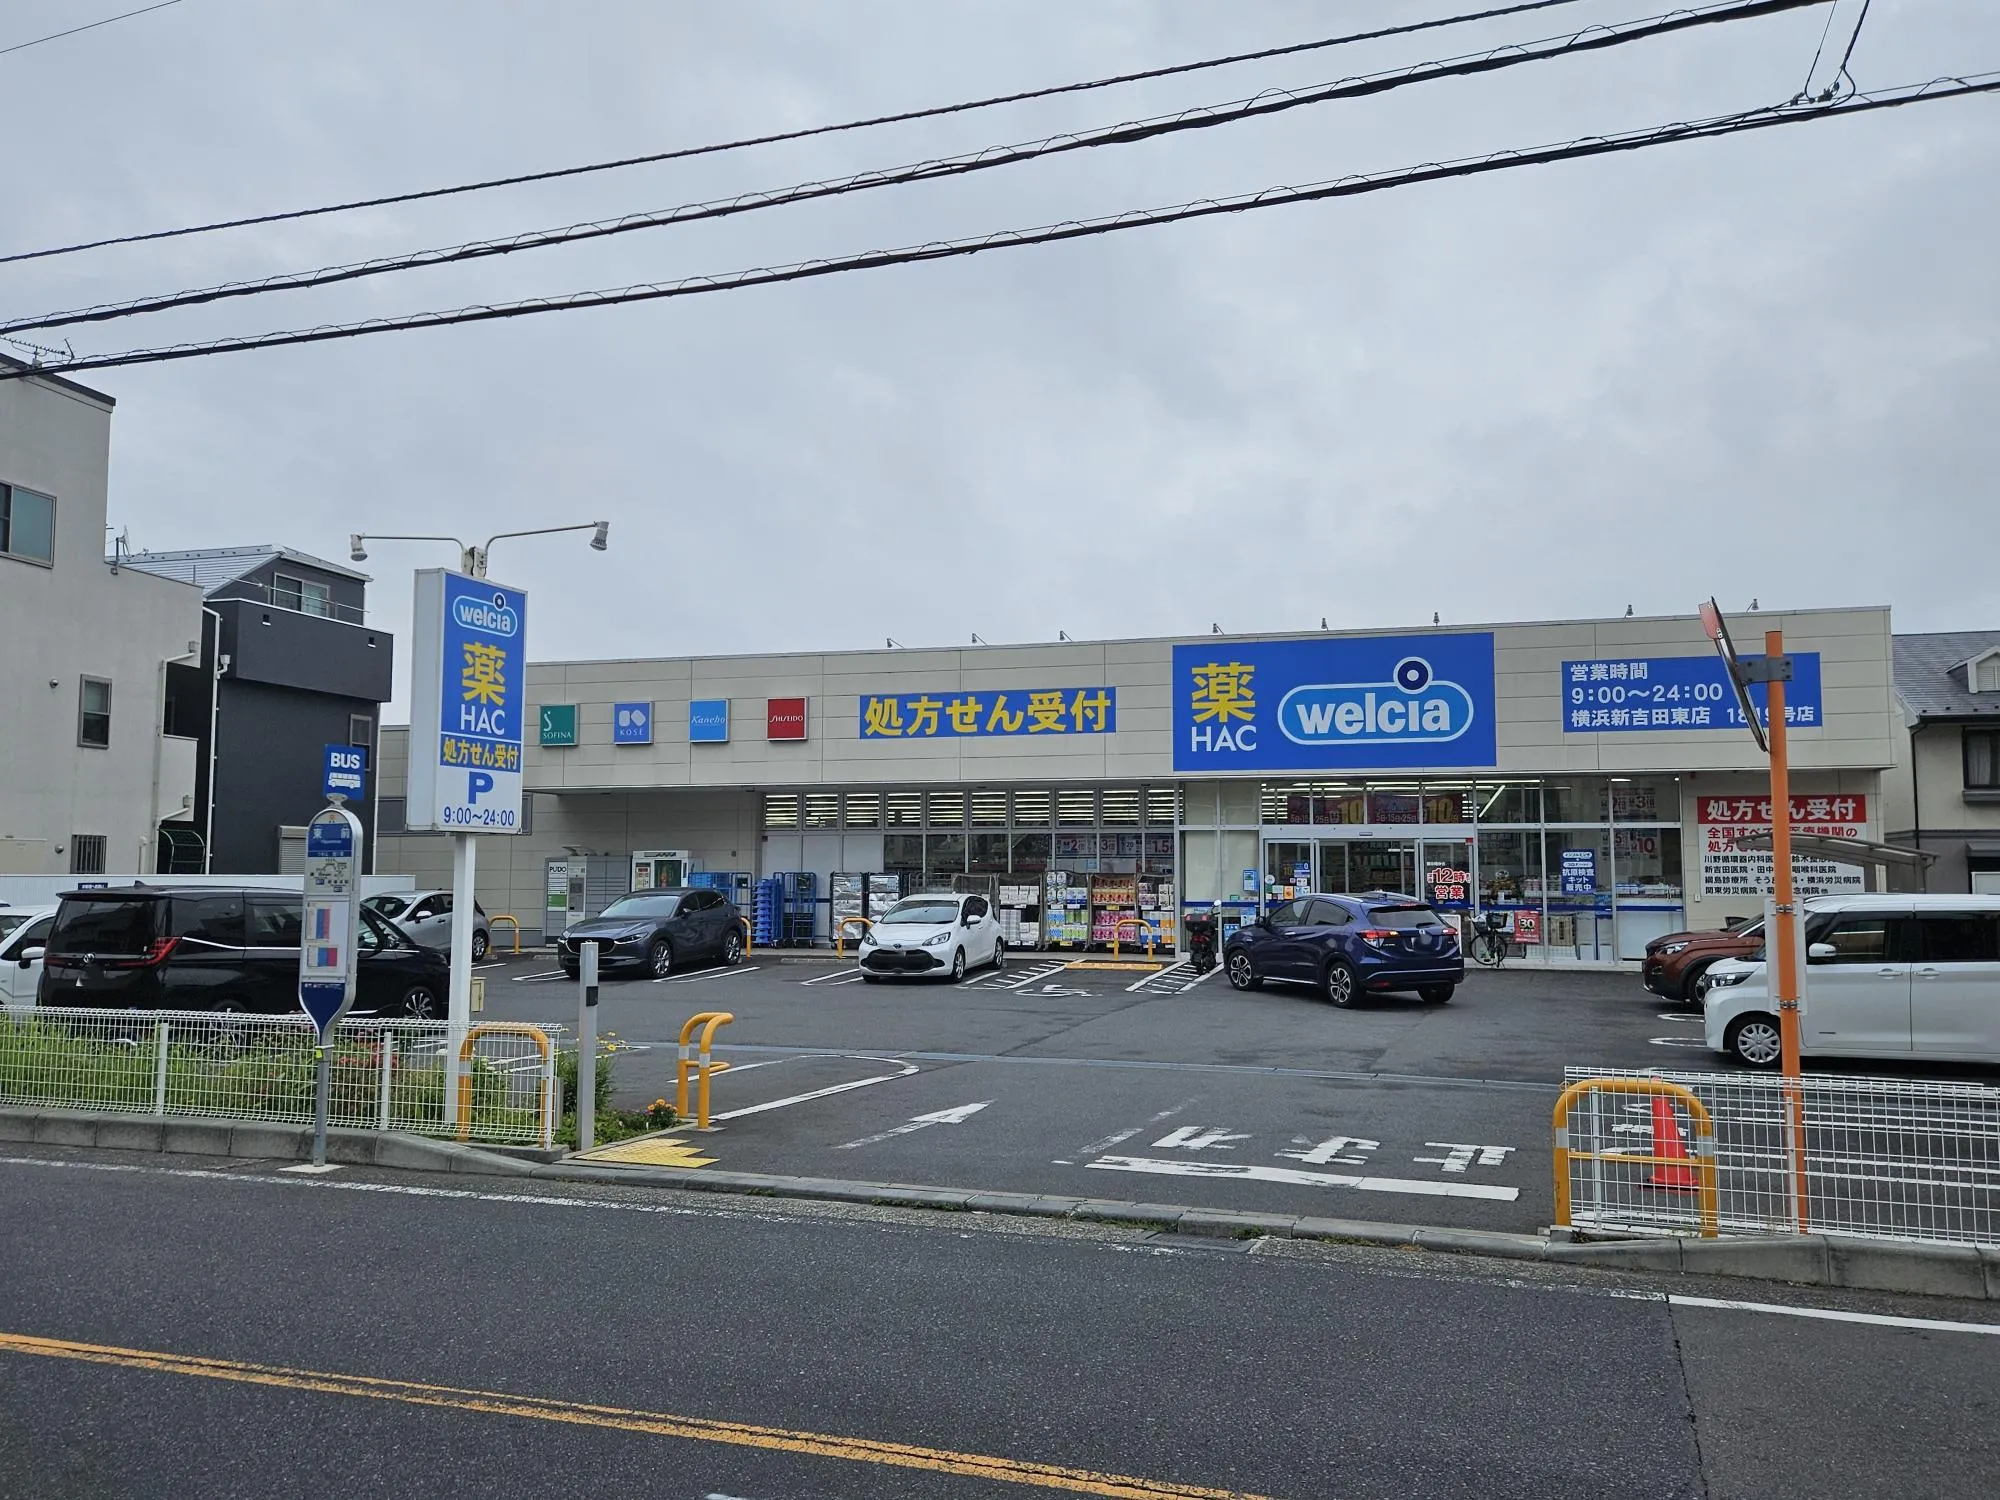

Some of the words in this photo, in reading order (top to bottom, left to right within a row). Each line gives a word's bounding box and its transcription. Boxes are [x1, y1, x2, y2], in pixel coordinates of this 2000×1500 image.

[460, 603, 511, 632] welcia
[462, 641, 506, 706] 薬
[1571, 662, 1648, 681] 営業時間
[1191, 661, 1255, 723] 薬
[460, 704, 506, 736] HAC
[864, 689, 1111, 736] 処方せん受付
[1296, 692, 1451, 735] welcia
[1571, 707, 1710, 727] 横浜新吉田東店
[543, 731, 572, 739] SOFINA
[1190, 725, 1257, 752] HAC
[330, 752, 361, 769] BUS
[443, 739, 519, 770] 処方せん受付
[467, 771, 494, 805] P
[1707, 798, 1856, 821] 処方せん受付
[1435, 885, 1464, 899] 営業
